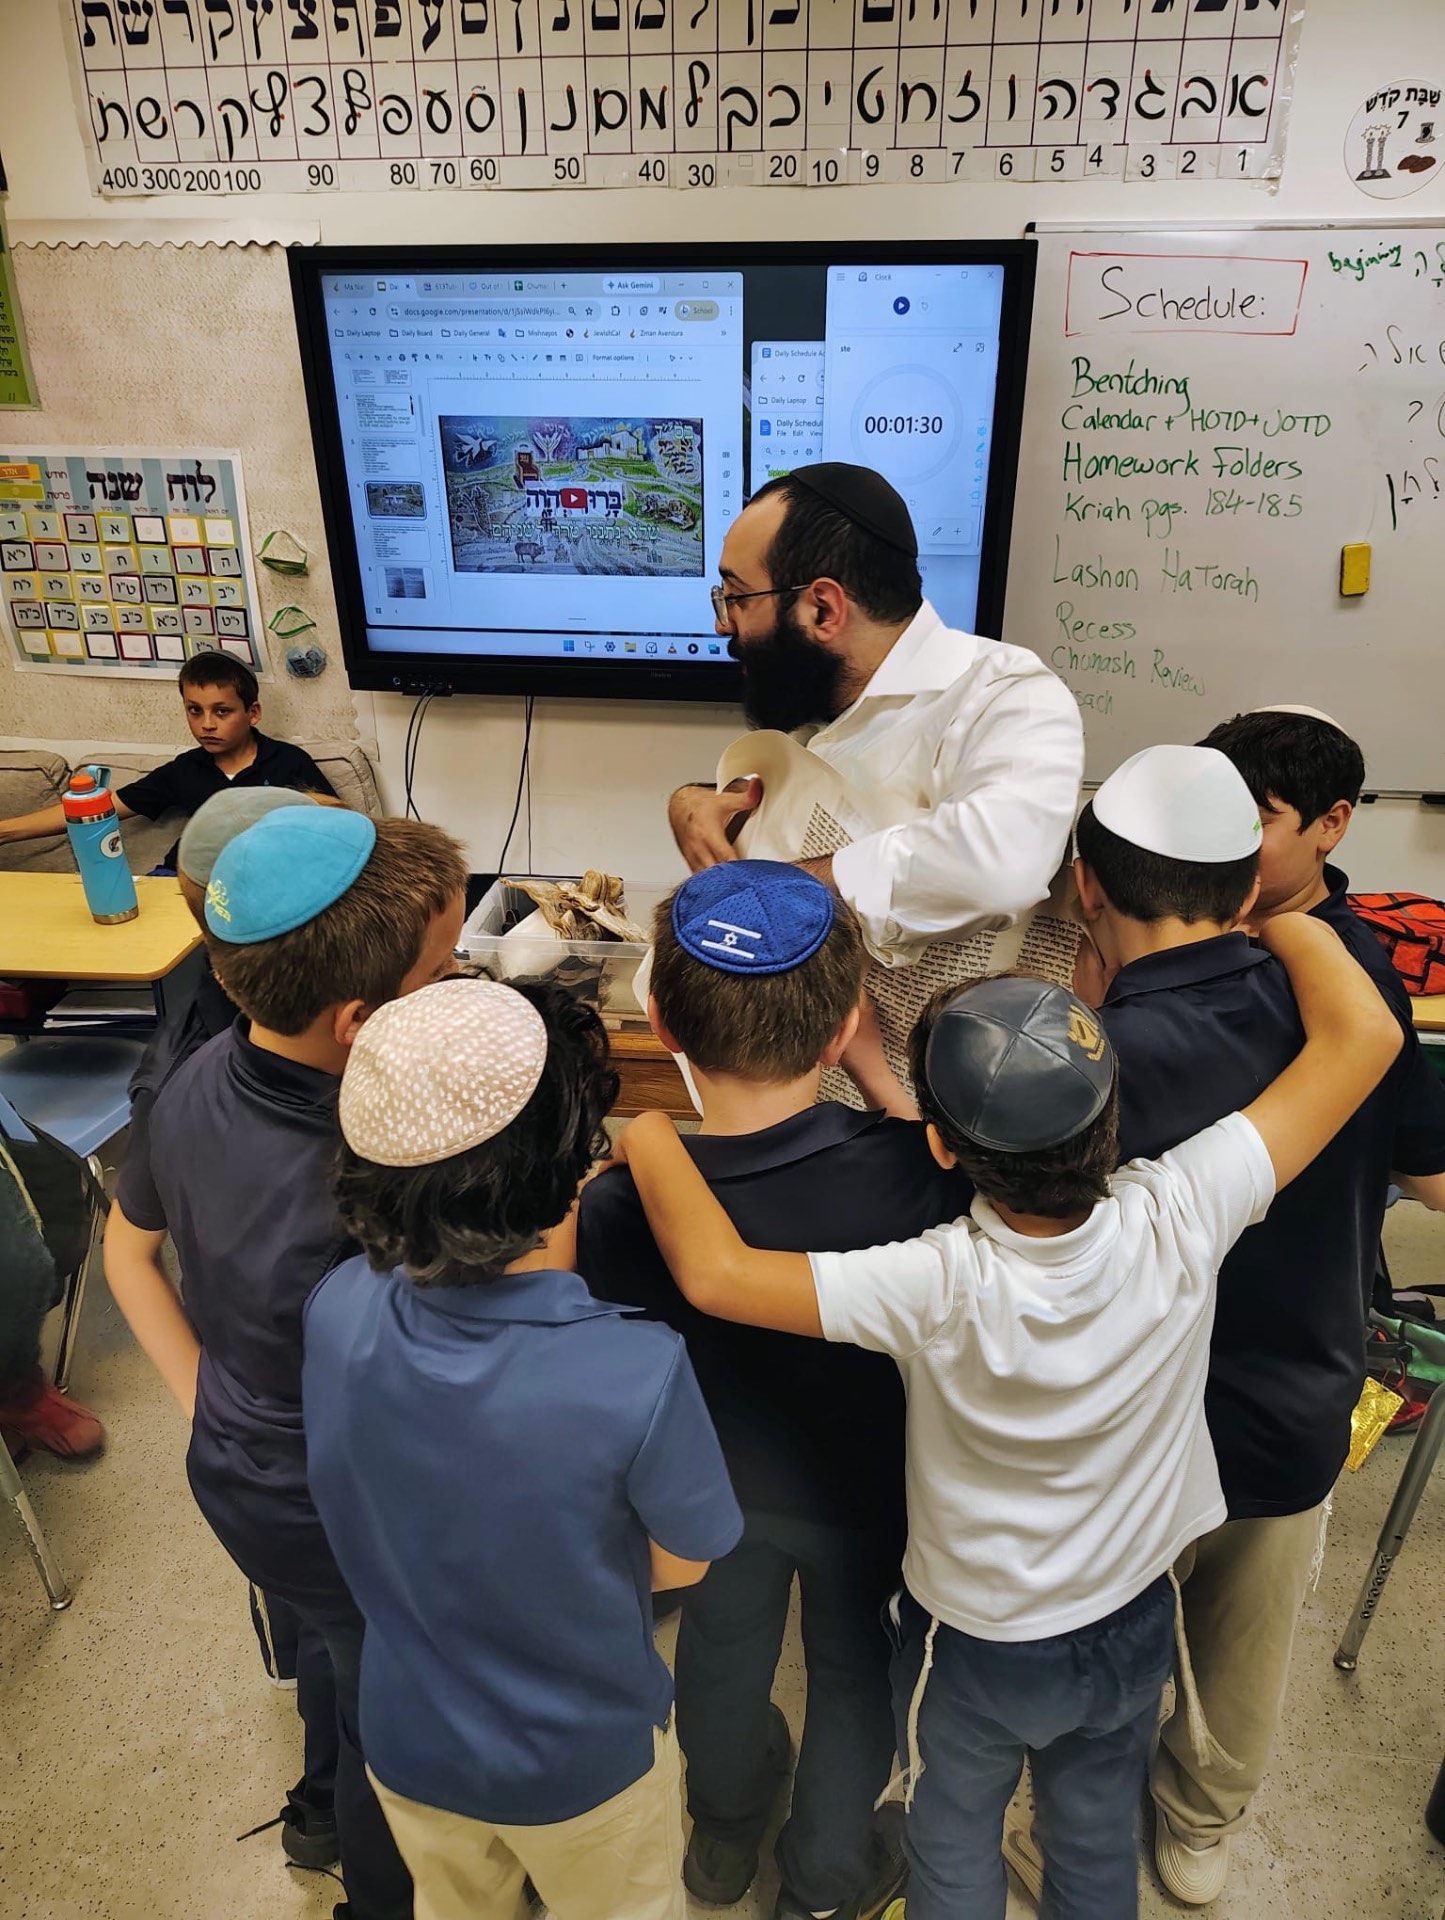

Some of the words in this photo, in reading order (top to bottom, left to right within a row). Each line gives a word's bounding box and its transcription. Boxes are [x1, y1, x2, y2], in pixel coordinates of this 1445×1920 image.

[82, 0, 116, 48] ת
[117, 0, 153, 46] ש
[163, 0, 195, 44] ר
[204, 0, 235, 62] ק
[248, 0, 274, 61] ץ
[290, 0, 320, 40] צ
[332, 0, 366, 59] ף
[373, 0, 403, 38] פ
[420, 0, 445, 54] ע
[293, 76, 331, 137] צ
[379, 94, 413, 136] פ
[422, 89, 453, 134] ע
[465, 92, 496, 133] ס
[550, 84, 577, 132] נ
[593, 88, 628, 136] ם
[640, 84, 668, 130] מ
[685, 60, 711, 128] ל
[767, 84, 801, 128] כ
[857, 66, 886, 124] ט
[900, 82, 938, 125] ח
[947, 70, 981, 123] ז
[1038, 79, 1077, 121] ה
[1086, 77, 1120, 120] ד
[1134, 69, 1166, 120] ג
[1181, 75, 1217, 119] ב
[1227, 74, 1269, 118] א
[97, 97, 130, 143] ת
[136, 97, 169, 139] ש
[174, 99, 206, 139] ר
[217, 98, 250, 162] ק
[517, 86, 527, 156] ן
[720, 86, 758, 151] ך
[1397, 111, 1409, 129] 7
[102, 167, 139, 190] 400
[141, 168, 181, 190] 300
[184, 169, 221, 192] 200
[224, 168, 261, 191] 100
[308, 164, 334, 187] 90
[390, 163, 415, 185] 80
[430, 163, 456, 185] 70
[470, 158, 496, 181] 60
[554, 157, 580, 181] 50
[638, 159, 666, 182] 40
[688, 164, 715, 187] 30
[769, 155, 797, 178] 20
[812, 159, 838, 182] 10
[866, 154, 880, 177] 9
[910, 154, 924, 177] 8
[951, 152, 965, 174] 7
[999, 153, 1014, 176] 6
[1050, 150, 1065, 173] 5
[1088, 145, 1104, 168] 4
[1141, 154, 1155, 178] 3
[1181, 151, 1197, 174] 2
[1238, 149, 1247, 172] 1
[617, 281, 629, 289] Ask
[630, 281, 653, 290] Gemini
[874, 273, 892, 281] Clock
[1099, 266, 1266, 321] Schedule:
[774, 350, 789, 358] Daily
[790, 349, 817, 357] Schedule
[771, 397, 786, 405] Daily
[1071, 356, 1190, 417] Bentching
[776, 419, 793, 429] Daily
[864, 415, 943, 434] 00:01:30
[1061, 404, 1158, 432] Calendar
[166, 459, 217, 503] לוח
[1063, 441, 1200, 484] Homework
[1212, 446, 1304, 480] Folders
[86, 470, 144, 501] שנה
[8, 520, 16, 531] ד
[41, 520, 49, 531] ג
[78, 523, 87, 534] ב
[110, 524, 120, 535] א
[1065, 492, 1131, 523] Kriah
[1141, 499, 1188, 540] pgs.
[1204, 487, 1304, 519] 184-185
[81, 552, 91, 563] ט
[117, 555, 128, 566] ח
[221, 557, 231, 568] ה
[1053, 534, 1139, 592] Lashon
[194, 615, 203, 627] כ
[1055, 601, 1137, 643] Recess
